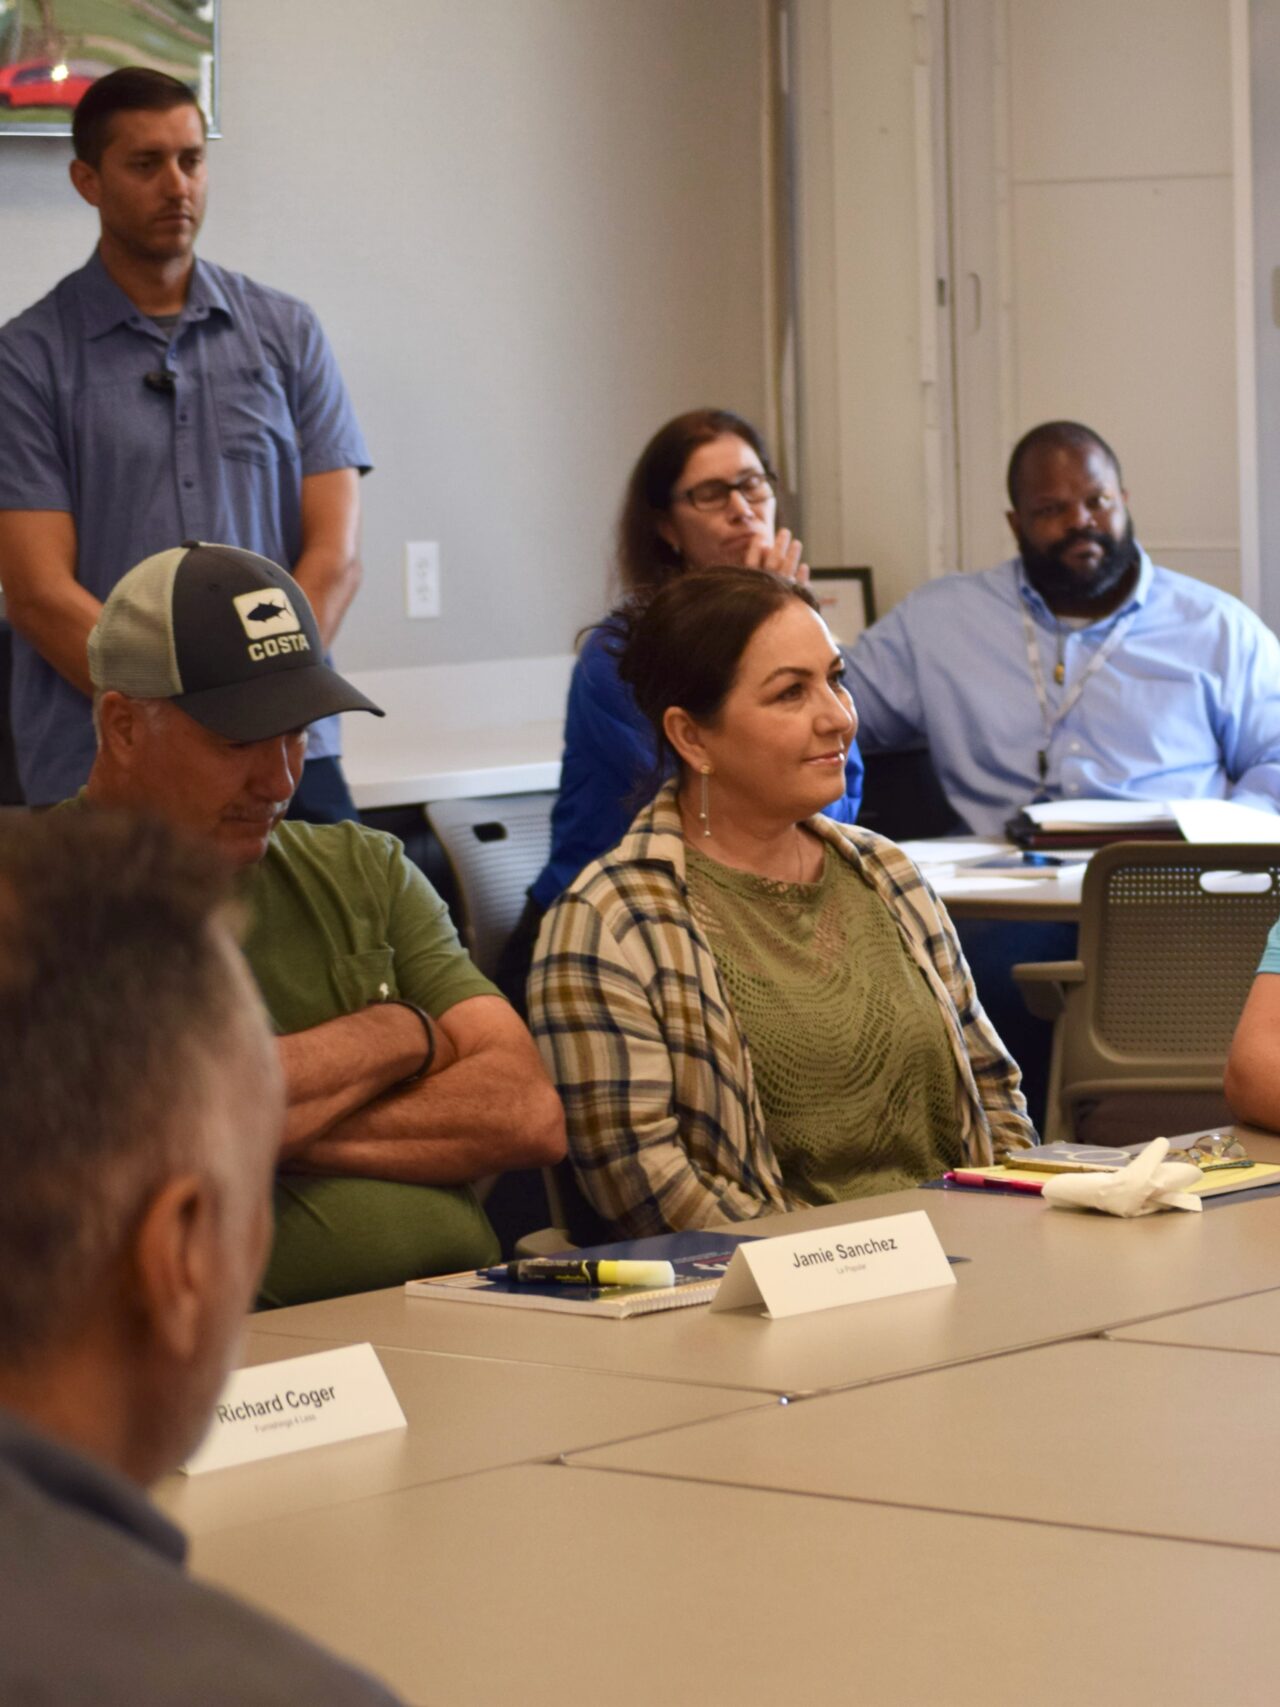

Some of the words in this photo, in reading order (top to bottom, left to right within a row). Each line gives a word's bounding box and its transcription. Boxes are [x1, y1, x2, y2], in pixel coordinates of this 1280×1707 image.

[248, 634, 310, 661] COSTA
[792, 1246, 835, 1269] Jamie
[835, 1237, 898, 1260] Sanchez
[216, 1394, 284, 1424] Richard
[285, 1385, 337, 1408] Coger
